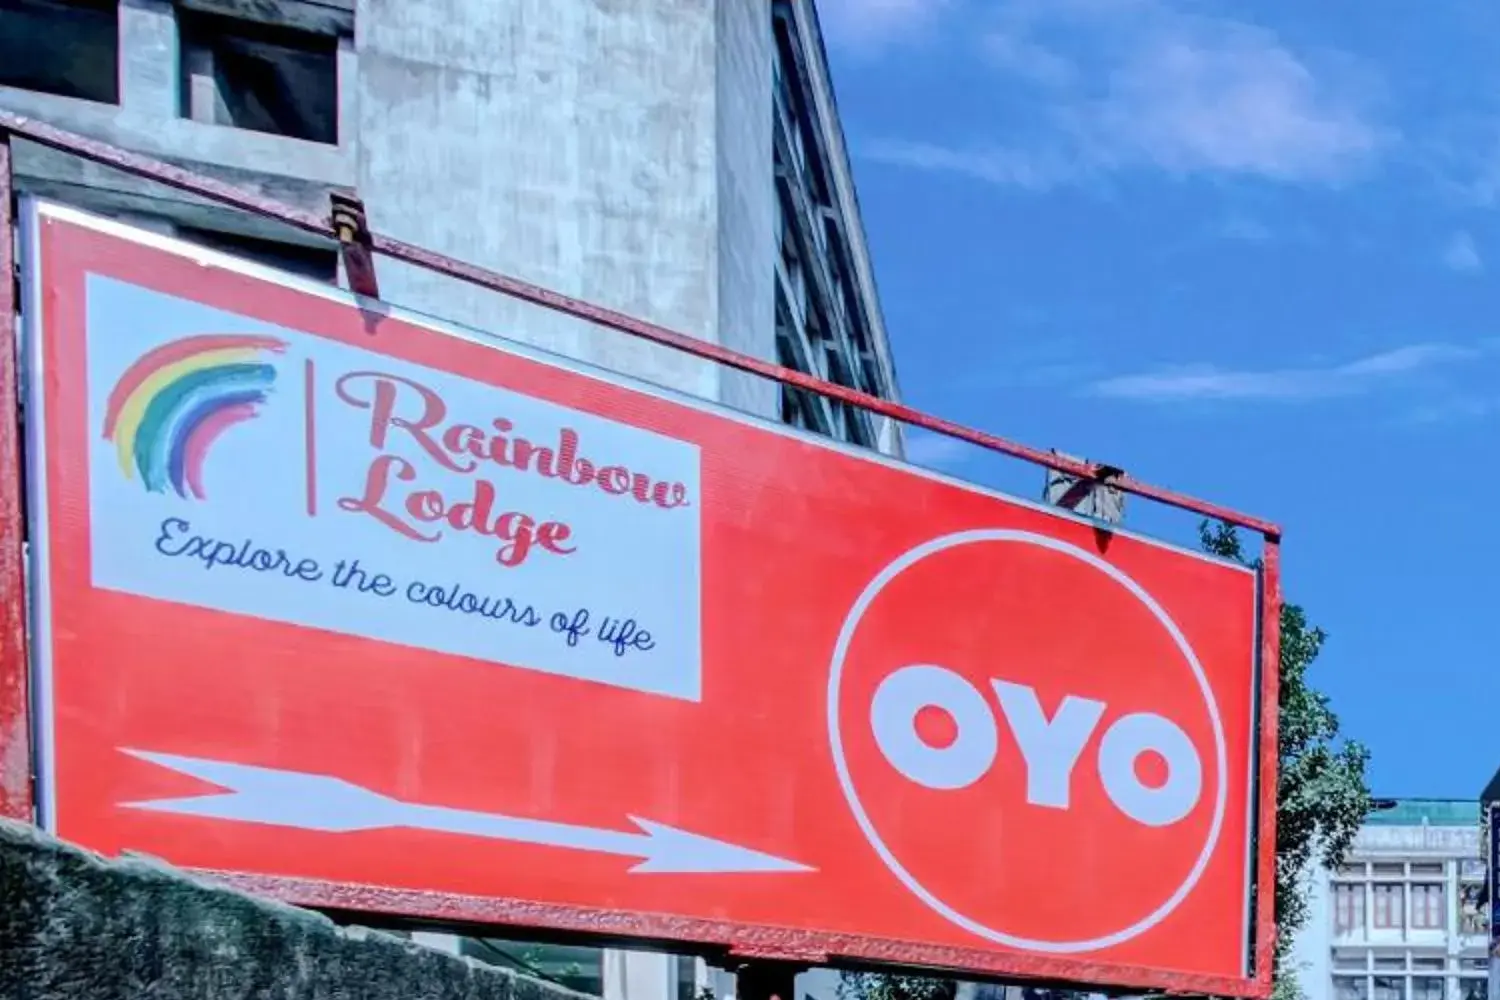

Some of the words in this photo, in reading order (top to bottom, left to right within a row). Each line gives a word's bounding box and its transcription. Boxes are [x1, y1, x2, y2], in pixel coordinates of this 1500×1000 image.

[335, 370, 690, 509] Rainbow
[337, 454, 577, 567] Lodge
[154, 517, 323, 583] Explore
[331, 558, 396, 597] the
[406, 581, 541, 630] colours
[550, 610, 590, 656] of
[598, 617, 656, 655] life
[870, 664, 1203, 827] OYO
